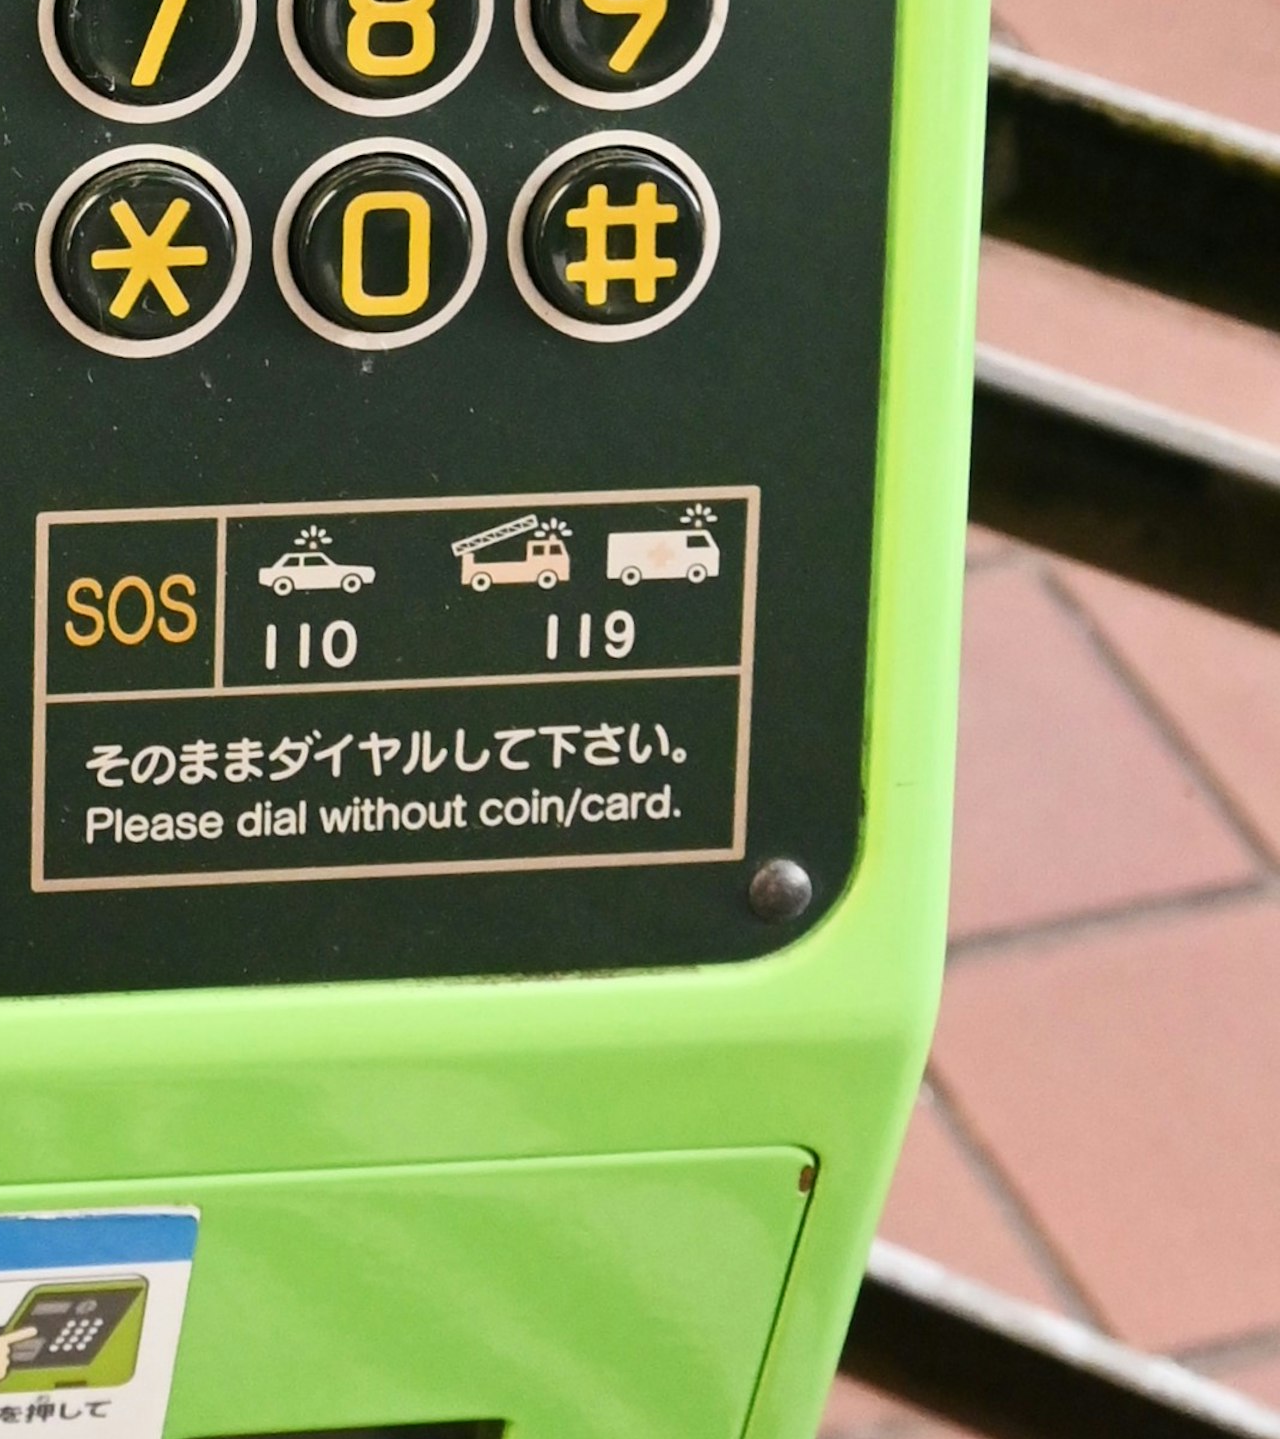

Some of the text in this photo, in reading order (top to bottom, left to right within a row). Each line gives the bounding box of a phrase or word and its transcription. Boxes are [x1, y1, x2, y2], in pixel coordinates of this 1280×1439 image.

[342, 192, 430, 316] 0
[566, 183, 677, 305] #
[67, 576, 196, 646] SOS
[548, 611, 634, 659] 119
[266, 621, 357, 669] 110
[85, 722, 688, 788] そのままダイヤルして下さい。
[87, 785, 680, 843] Please dial without coin/card.
